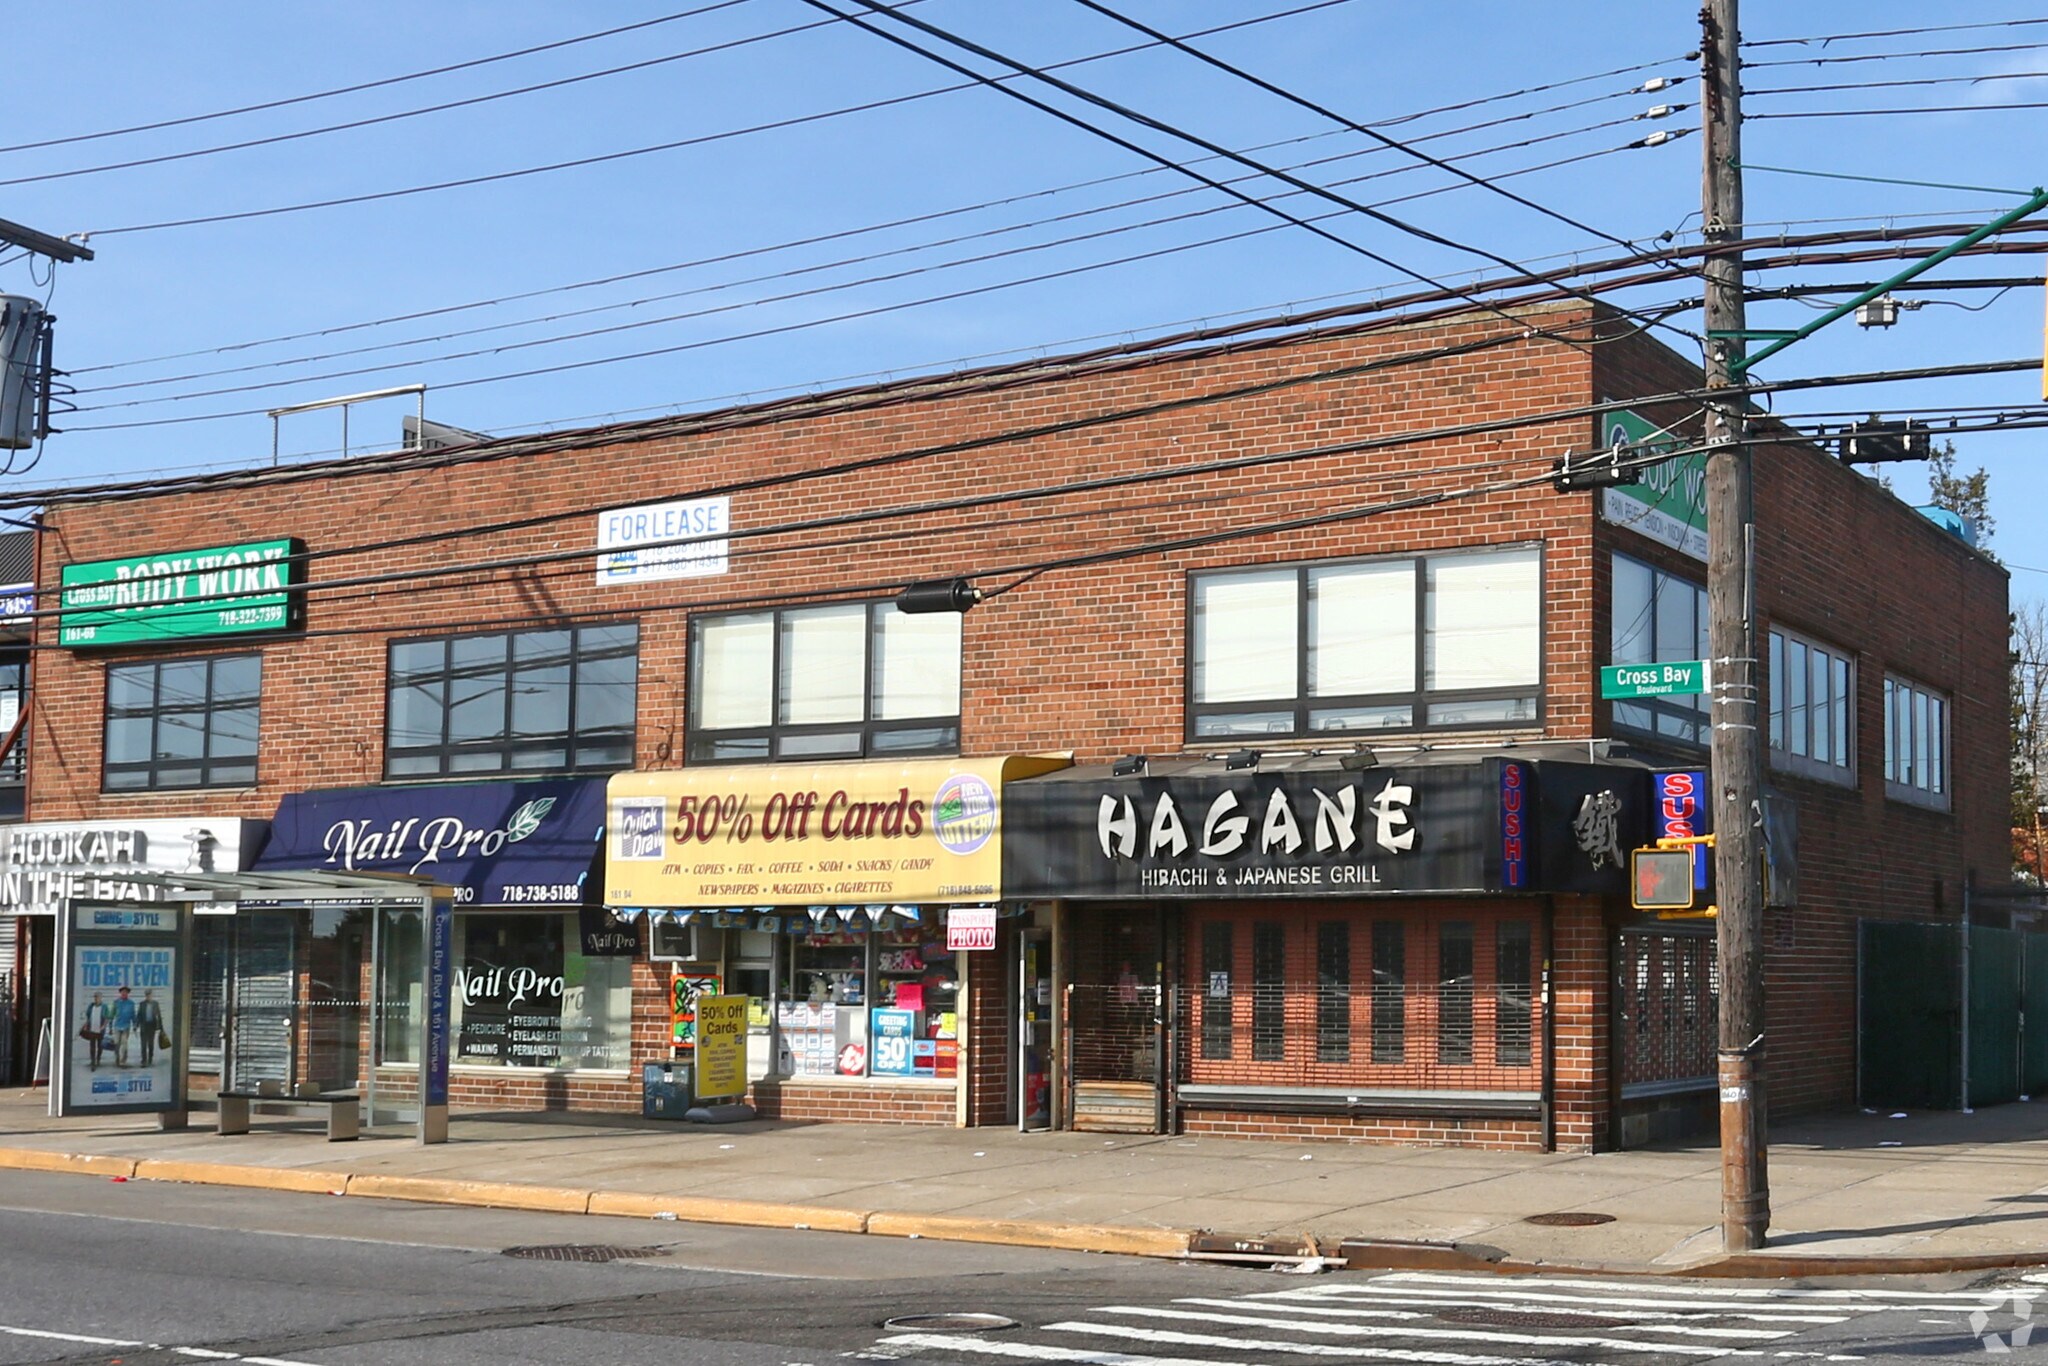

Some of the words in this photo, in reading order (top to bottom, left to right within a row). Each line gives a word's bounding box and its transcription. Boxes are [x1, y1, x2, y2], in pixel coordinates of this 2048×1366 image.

[1682, 461, 1708, 515] WO
[608, 513, 648, 543] FOR
[652, 505, 719, 538] LEASE
[196, 547, 284, 605] WORK
[1616, 668, 1658, 686] Cross
[1663, 665, 1692, 686] Bay
[1636, 684, 1673, 695] Boulevard
[622, 807, 659, 840] Quick
[672, 793, 753, 844] 50%
[761, 790, 819, 843] Off
[821, 787, 926, 842] Cards
[1096, 778, 1415, 860] HAGANE
[1504, 764, 1521, 886] SUSHI
[1662, 773, 1696, 866] SUS
[10, 830, 136, 865] HOOKAH
[322, 817, 419, 873] Nail
[409, 816, 508, 875] Pro
[632, 829, 664, 858] Draw
[661, 863, 682, 876] ATM
[692, 862, 726, 876] COPIES
[736, 863, 756, 875] FAX
[767, 861, 804, 875] COFFEE
[816, 860, 844, 873] SODA
[855, 859, 893, 872] SNACKS
[900, 858, 935, 872] CANDY
[1141, 867, 1208, 888] HIBACHI
[1216, 868, 1228, 886] &
[1234, 865, 1322, 887] JAPANESE
[1329, 864, 1382, 885] GRILL
[27, 870, 86, 903] THE
[502, 884, 579, 902] 718-738-5188
[697, 884, 760, 896] NEWSPAPERS
[770, 882, 825, 896] MAGAZINES
[833, 881, 894, 895] CIGARETTES
[133, 912, 160, 926] STYLE
[951, 914, 992, 926] PASSPORT
[434, 915, 445, 948] Cross
[588, 933, 611, 953] Nail
[612, 933, 636, 954] Pro
[950, 928, 993, 947] PHOTO
[431, 950, 444, 972] Bay
[82, 964, 101, 987] TO
[103, 964, 131, 987] GET
[433, 973, 443, 999] Blvd
[455, 966, 505, 1007] Nail
[507, 966, 565, 1010] Pro
[701, 1006, 725, 1020] 50%
[727, 1005, 744, 1019] Off
[706, 1021, 738, 1035] Cards
[431, 1031, 442, 1073] Avenue
[470, 1043, 499, 1055] WAXING
[877, 1060, 906, 1070] OFF
[128, 1080, 152, 1093] STYLE
